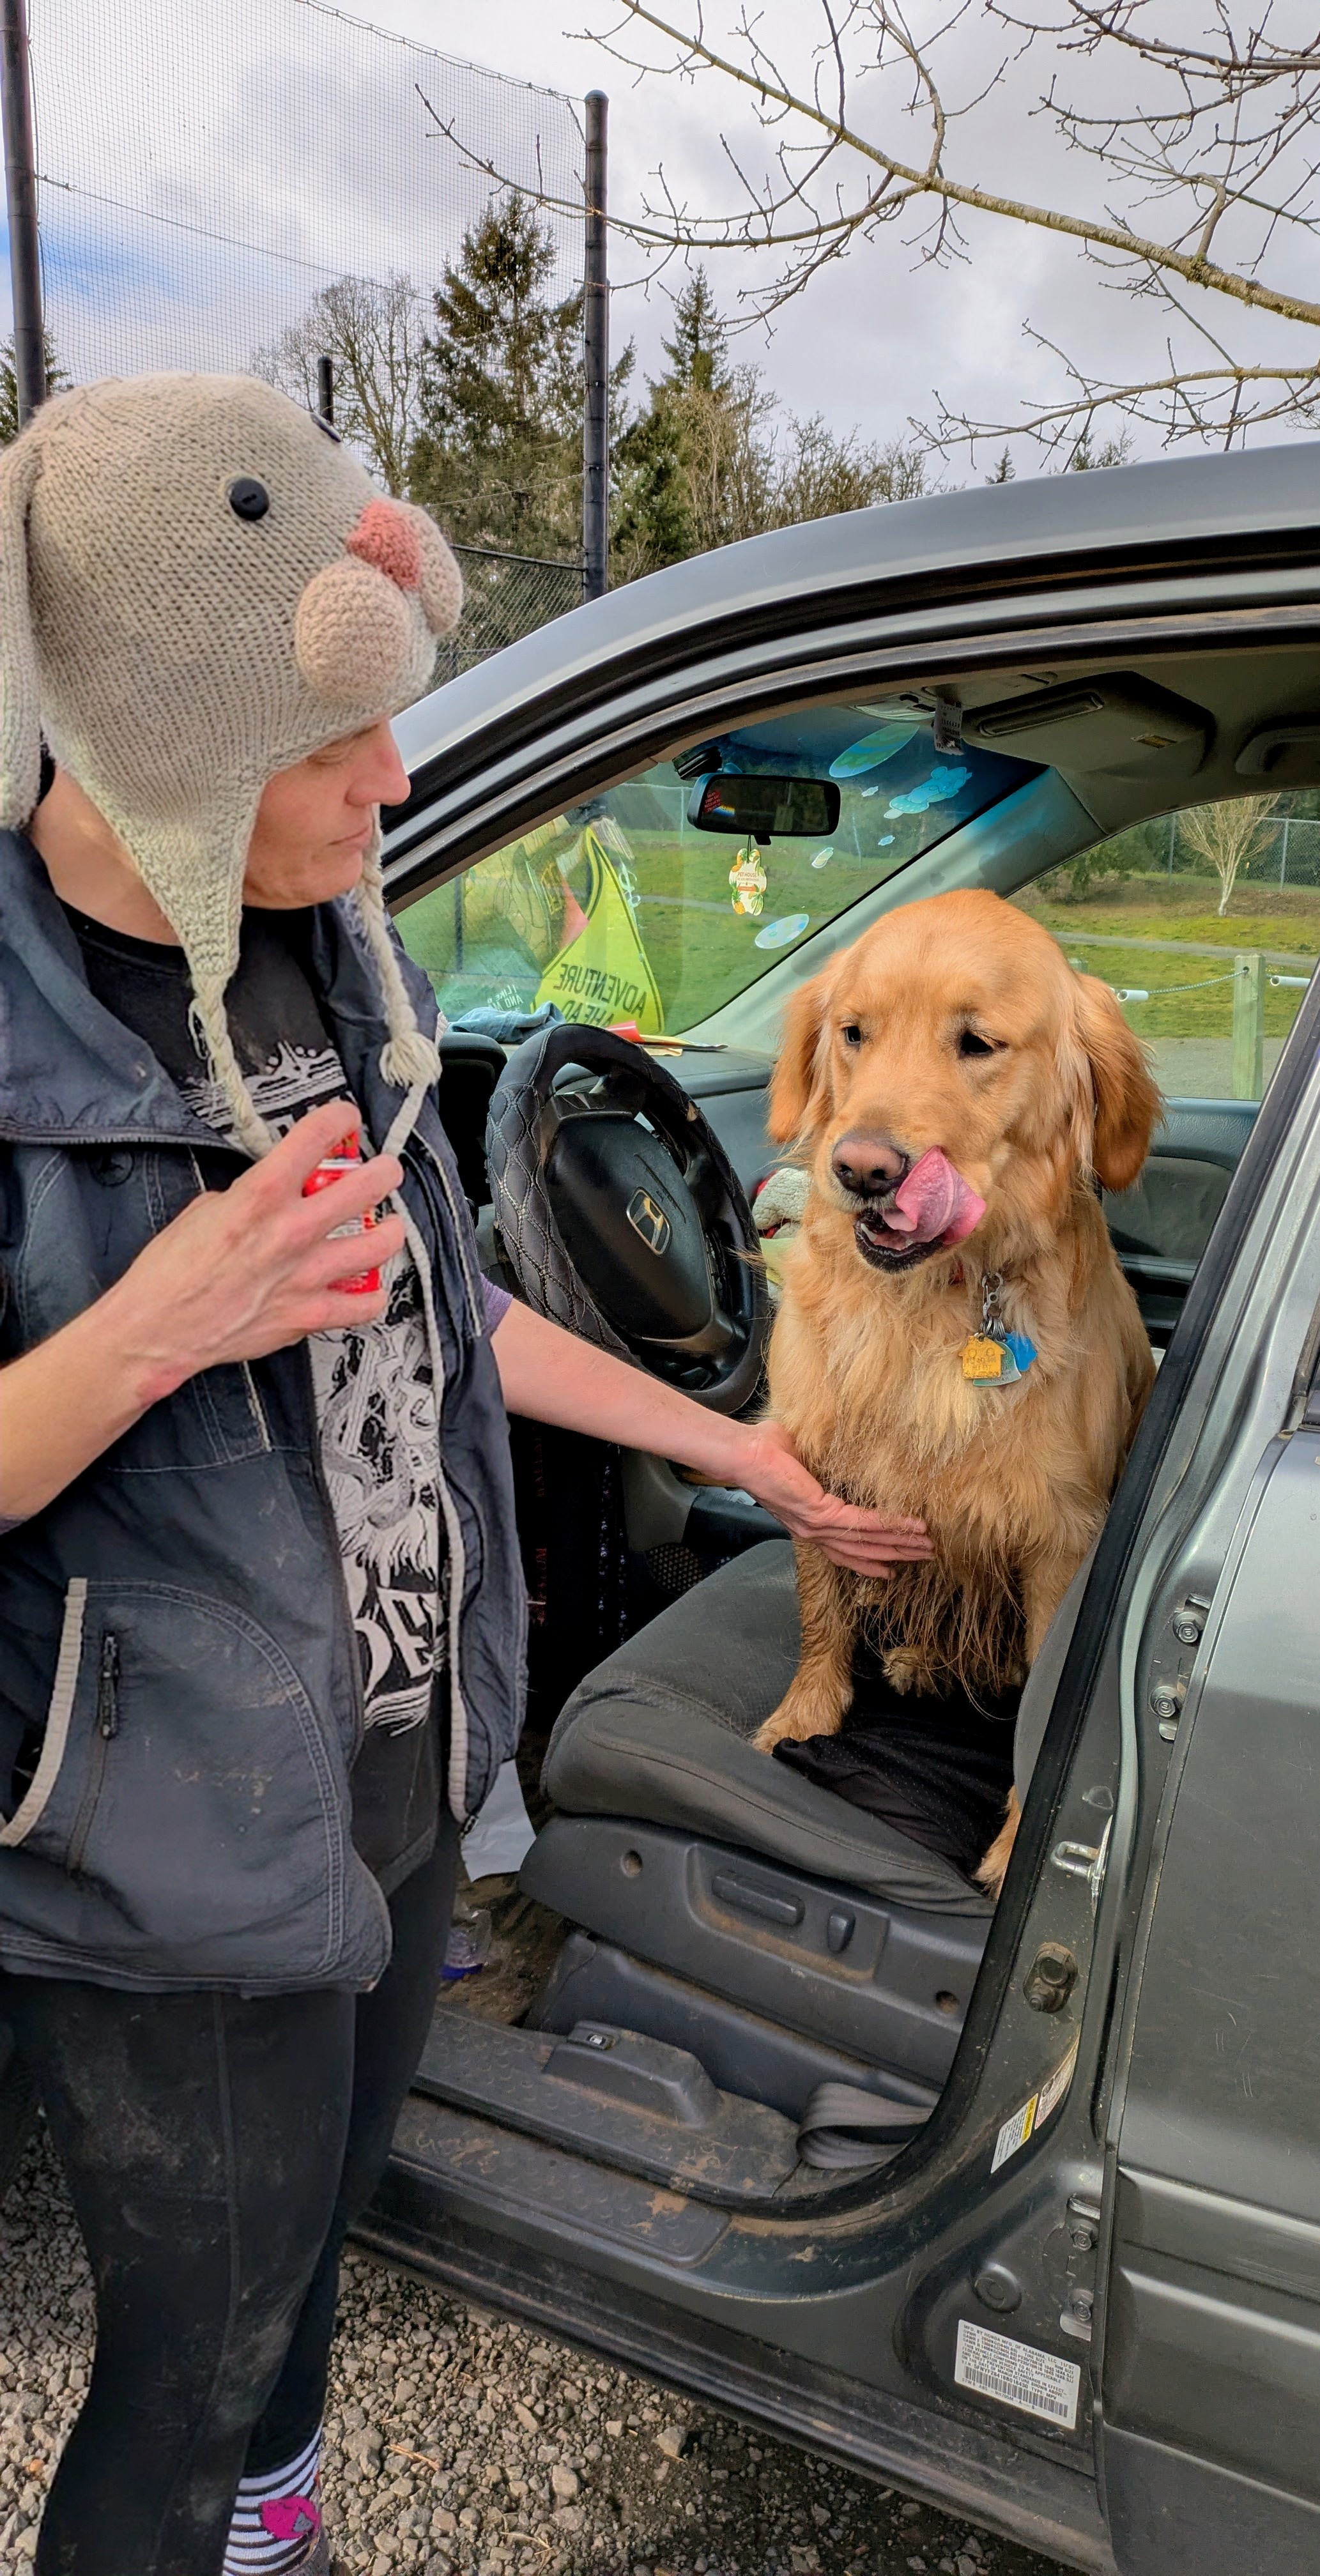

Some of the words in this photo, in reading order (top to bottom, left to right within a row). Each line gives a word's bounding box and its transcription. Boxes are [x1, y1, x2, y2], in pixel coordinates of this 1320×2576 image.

[984, 2332, 1000, 2342] HONDA
[962, 2346, 980, 2356] FEDERAL
[982, 2354, 997, 2363] MOTOR
[998, 2359, 1016, 2370] VEHICLE
[1017, 2367, 1034, 2377] SAFETY
[972, 2354, 985, 2363] THEFT
[986, 2359, 1013, 2373] PREVENTION
[1014, 2371, 1041, 2384] STANDARDS
[974, 2347, 992, 2357] VEHICLE
[993, 2354, 1017, 2366] CONFORMS
[1034, 2370, 1061, 2384] APPLICABLE
[997, 2368, 1029, 2384] MANUFACTURE
[1031, 2381, 1047, 2391] SHOWN
[1046, 2392, 1057, 2400] MPV
